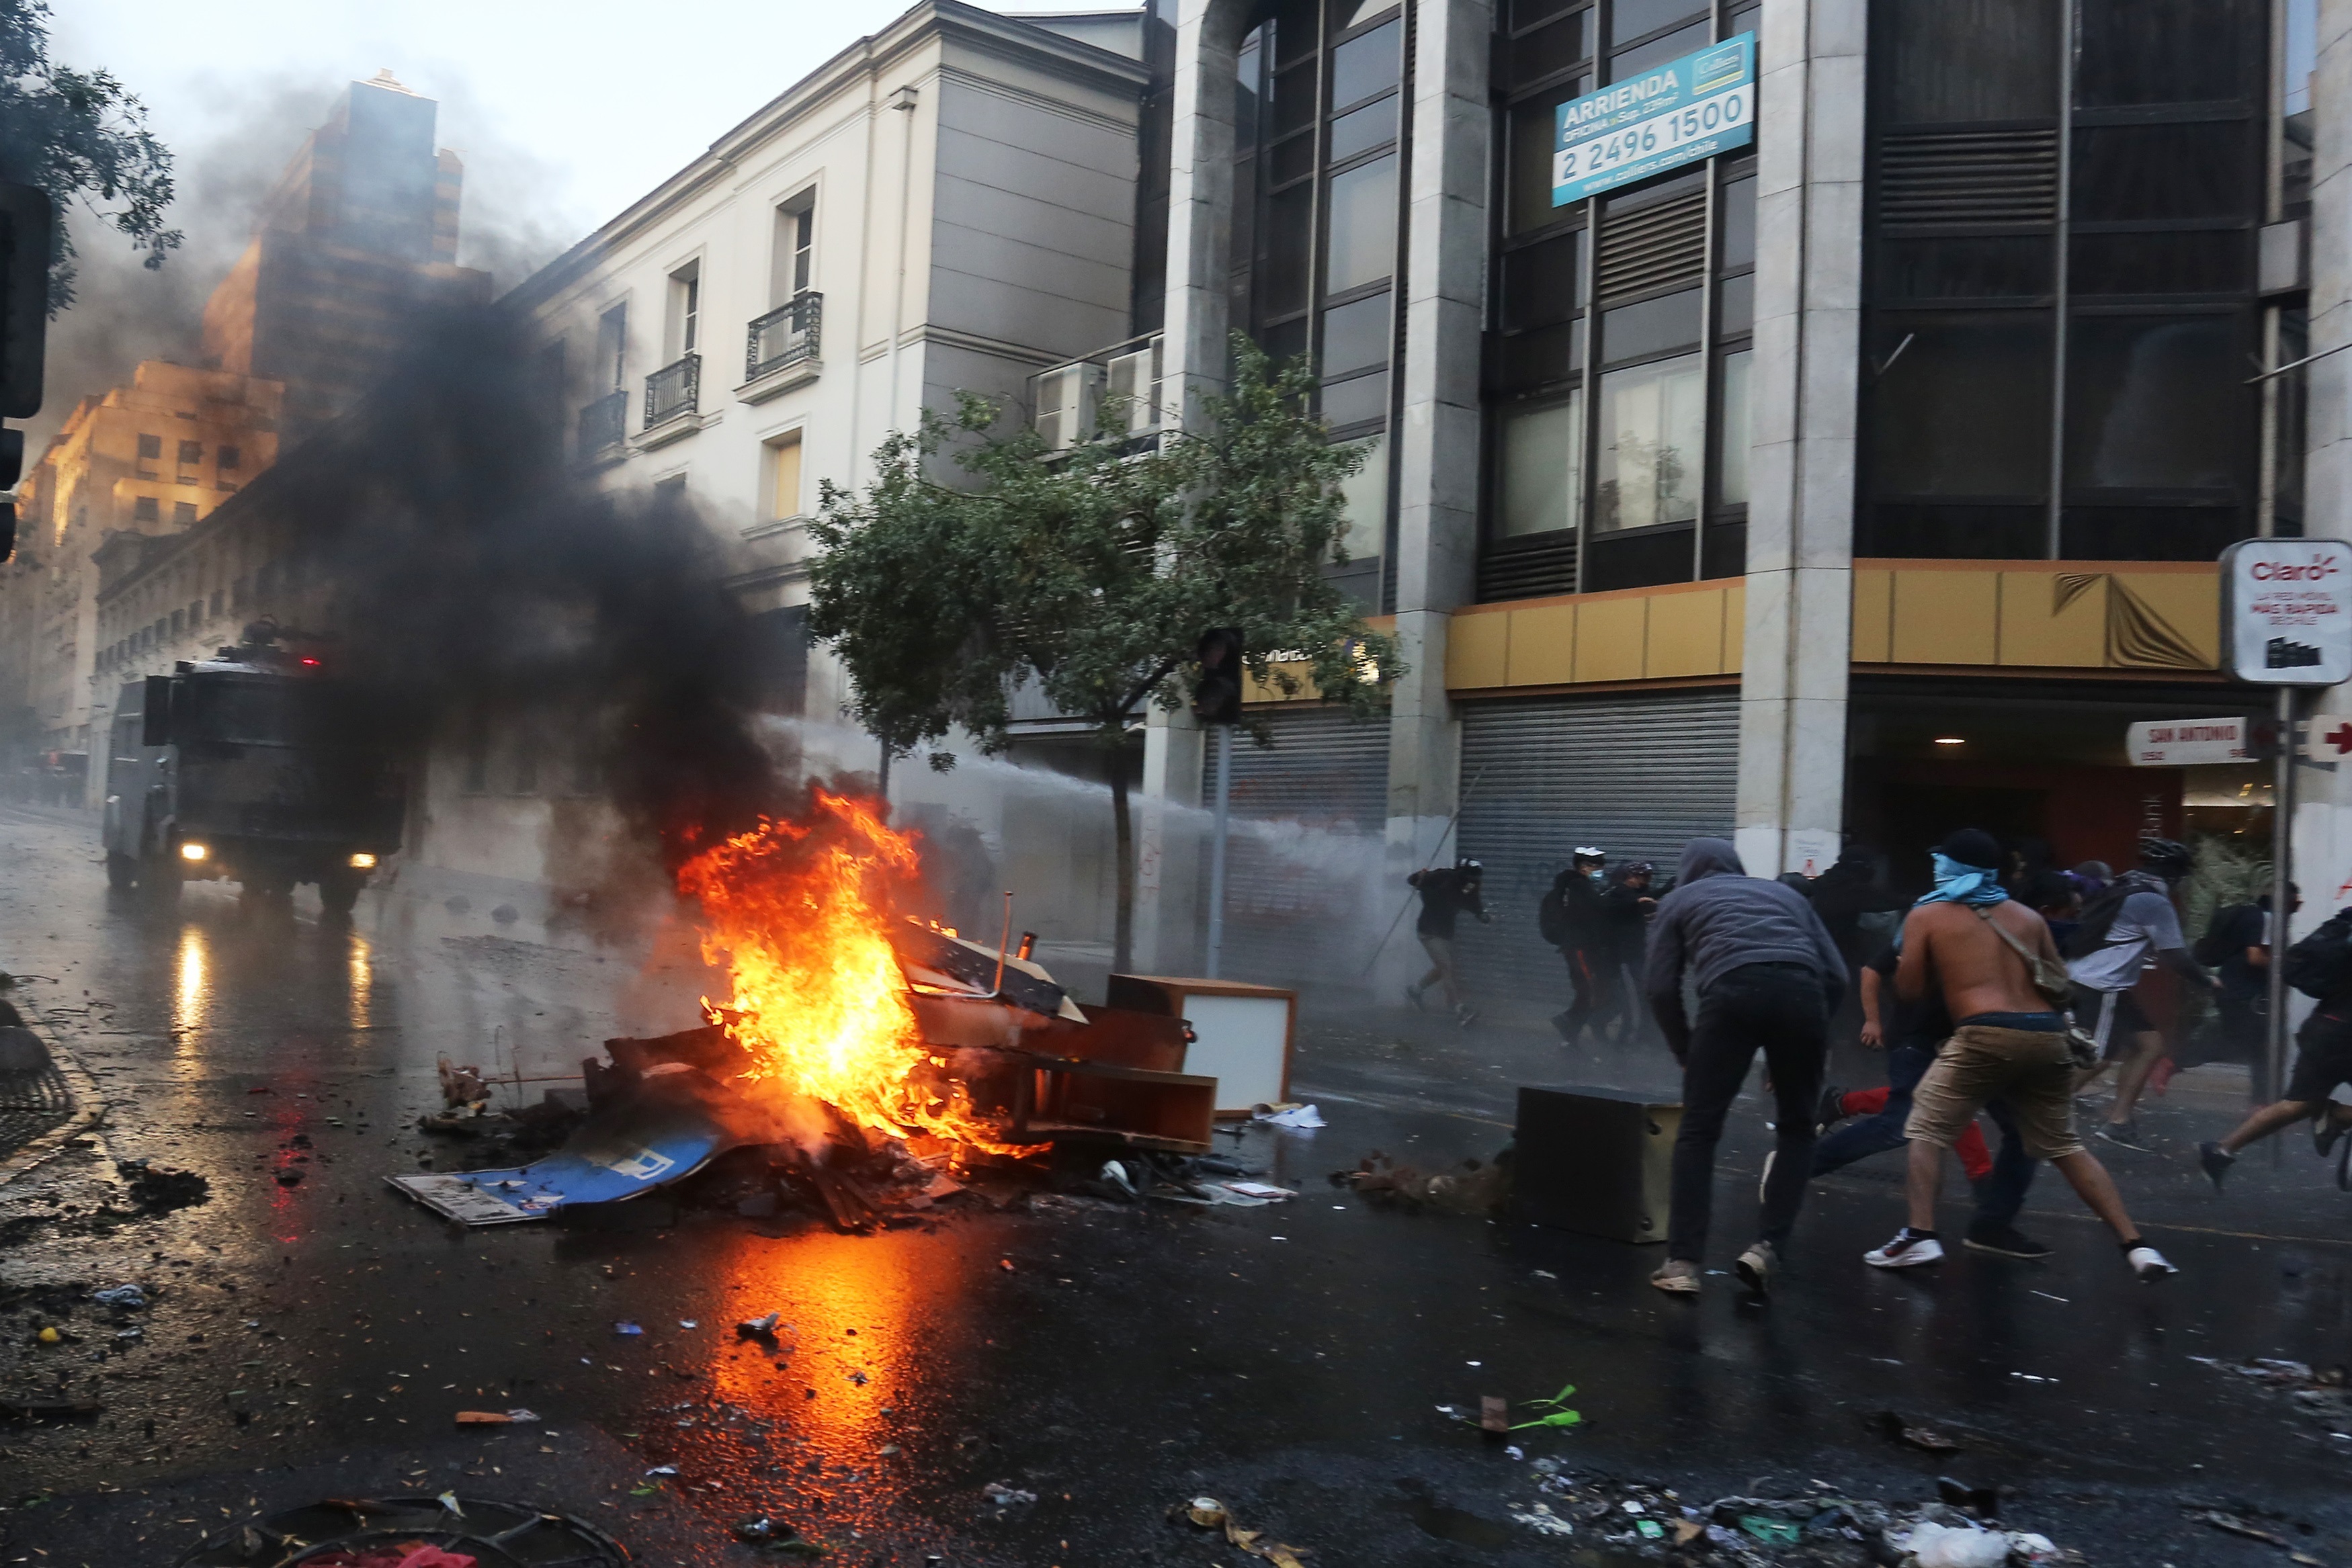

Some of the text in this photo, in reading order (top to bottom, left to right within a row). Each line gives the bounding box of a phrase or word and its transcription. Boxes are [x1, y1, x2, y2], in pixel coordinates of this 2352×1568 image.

[1563, 69, 1679, 129] ARRIENDA
[1562, 118, 1609, 143] OFICINA
[1562, 94, 1742, 179] 2 2496 1500
[1583, 139, 1718, 191] www.colliers.com/chile
[2251, 560, 2328, 581] Claro
[2149, 725, 2237, 743] SAN ANTONIO
